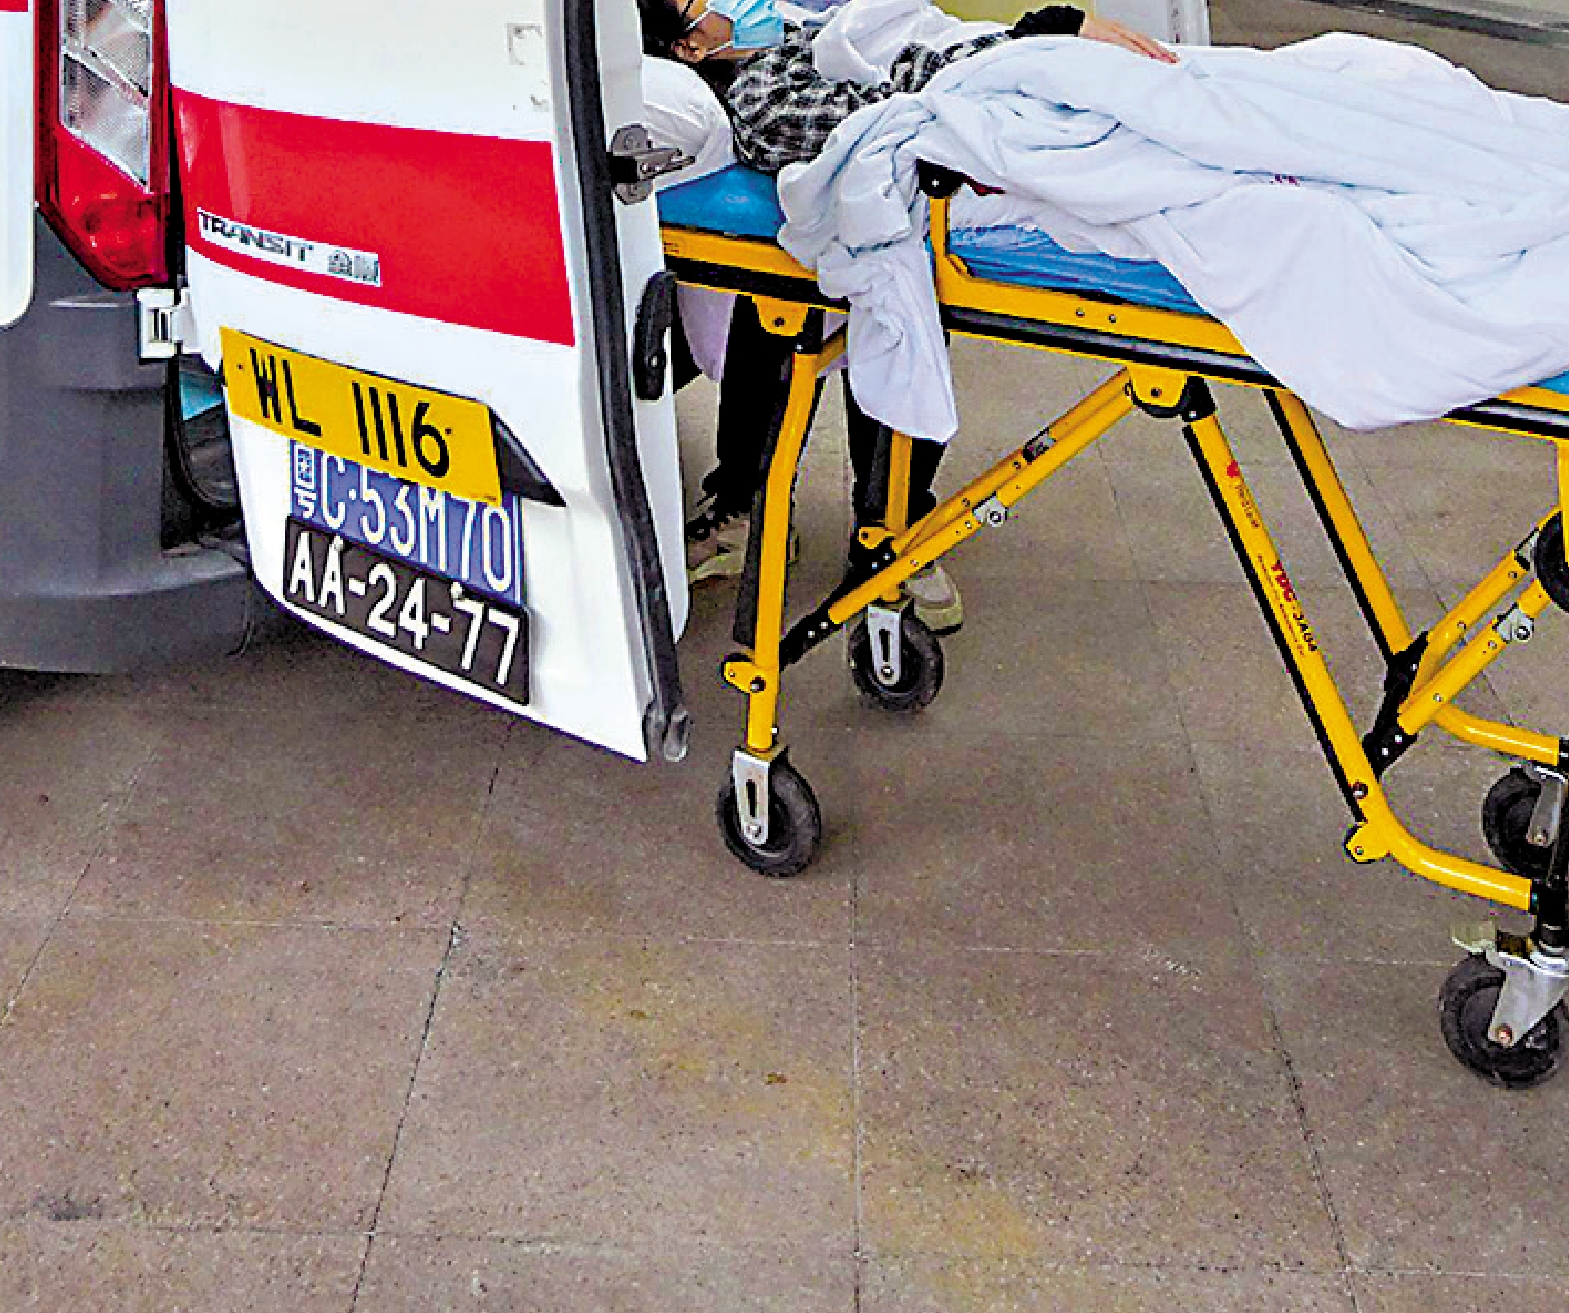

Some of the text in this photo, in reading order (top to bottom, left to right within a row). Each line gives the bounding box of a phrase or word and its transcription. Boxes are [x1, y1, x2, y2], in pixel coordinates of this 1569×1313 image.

[198, 209, 313, 262] TRANSIT
[249, 346, 323, 437] WL
[289, 531, 521, 686] AA-24-77
